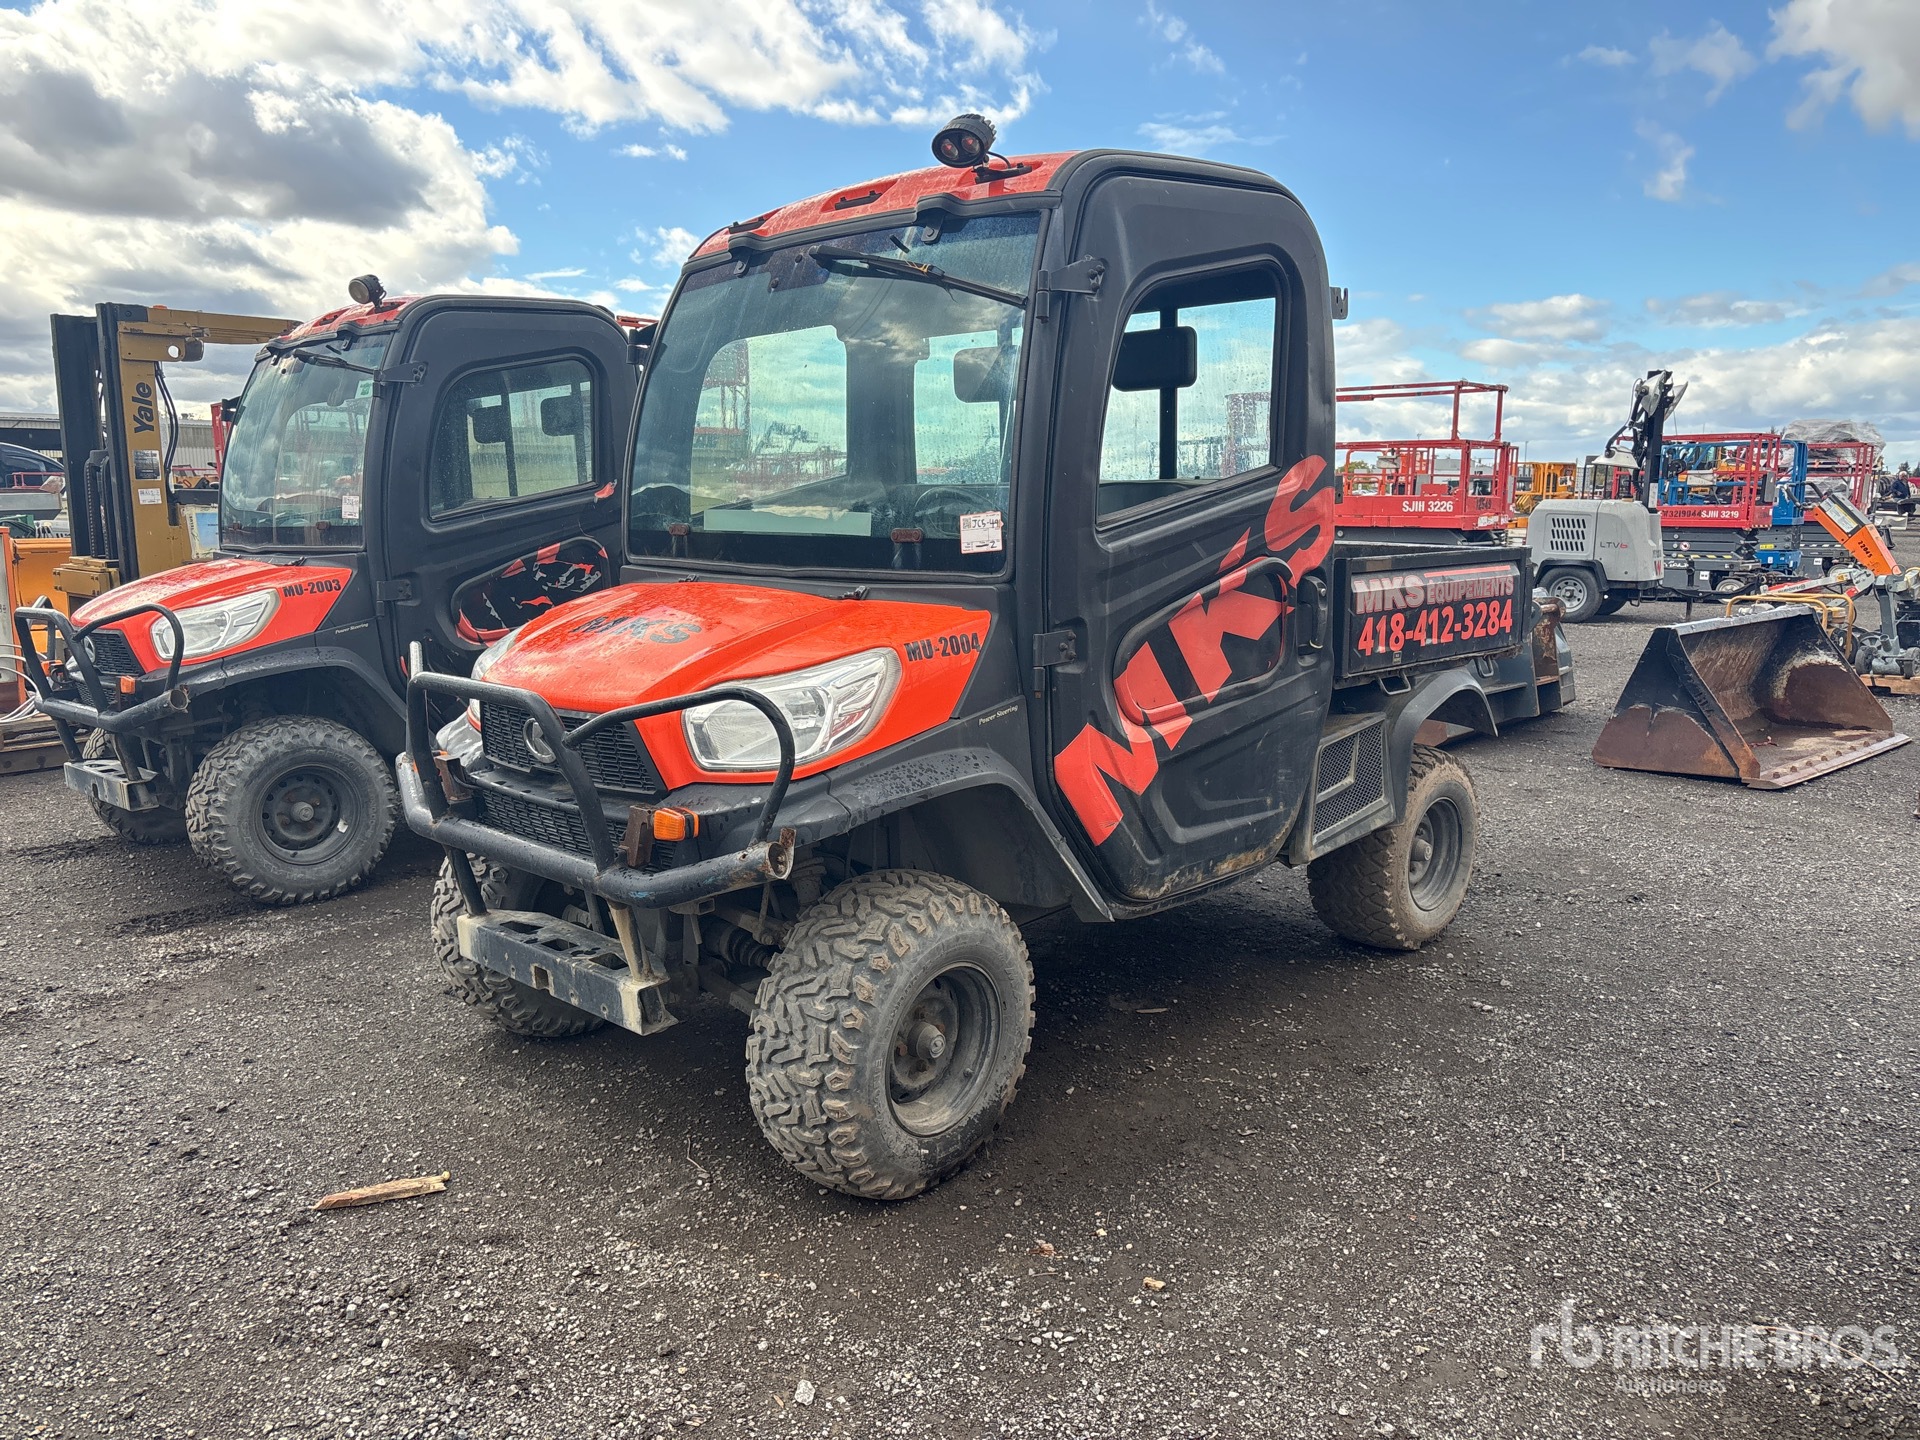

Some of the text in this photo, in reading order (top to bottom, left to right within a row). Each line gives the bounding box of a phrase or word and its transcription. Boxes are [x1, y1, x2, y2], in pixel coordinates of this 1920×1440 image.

[131, 381, 155, 434] Yale
[1427, 500, 1454, 512] 3226
[1720, 510, 1739, 518] 3219
[282, 578, 342, 598] MU-2003
[1353, 574, 1425, 615] MKS
[1357, 598, 1513, 656] 418-412-3284
[903, 632, 981, 662] MU-2004
[978, 704, 1019, 726] Power Steering
